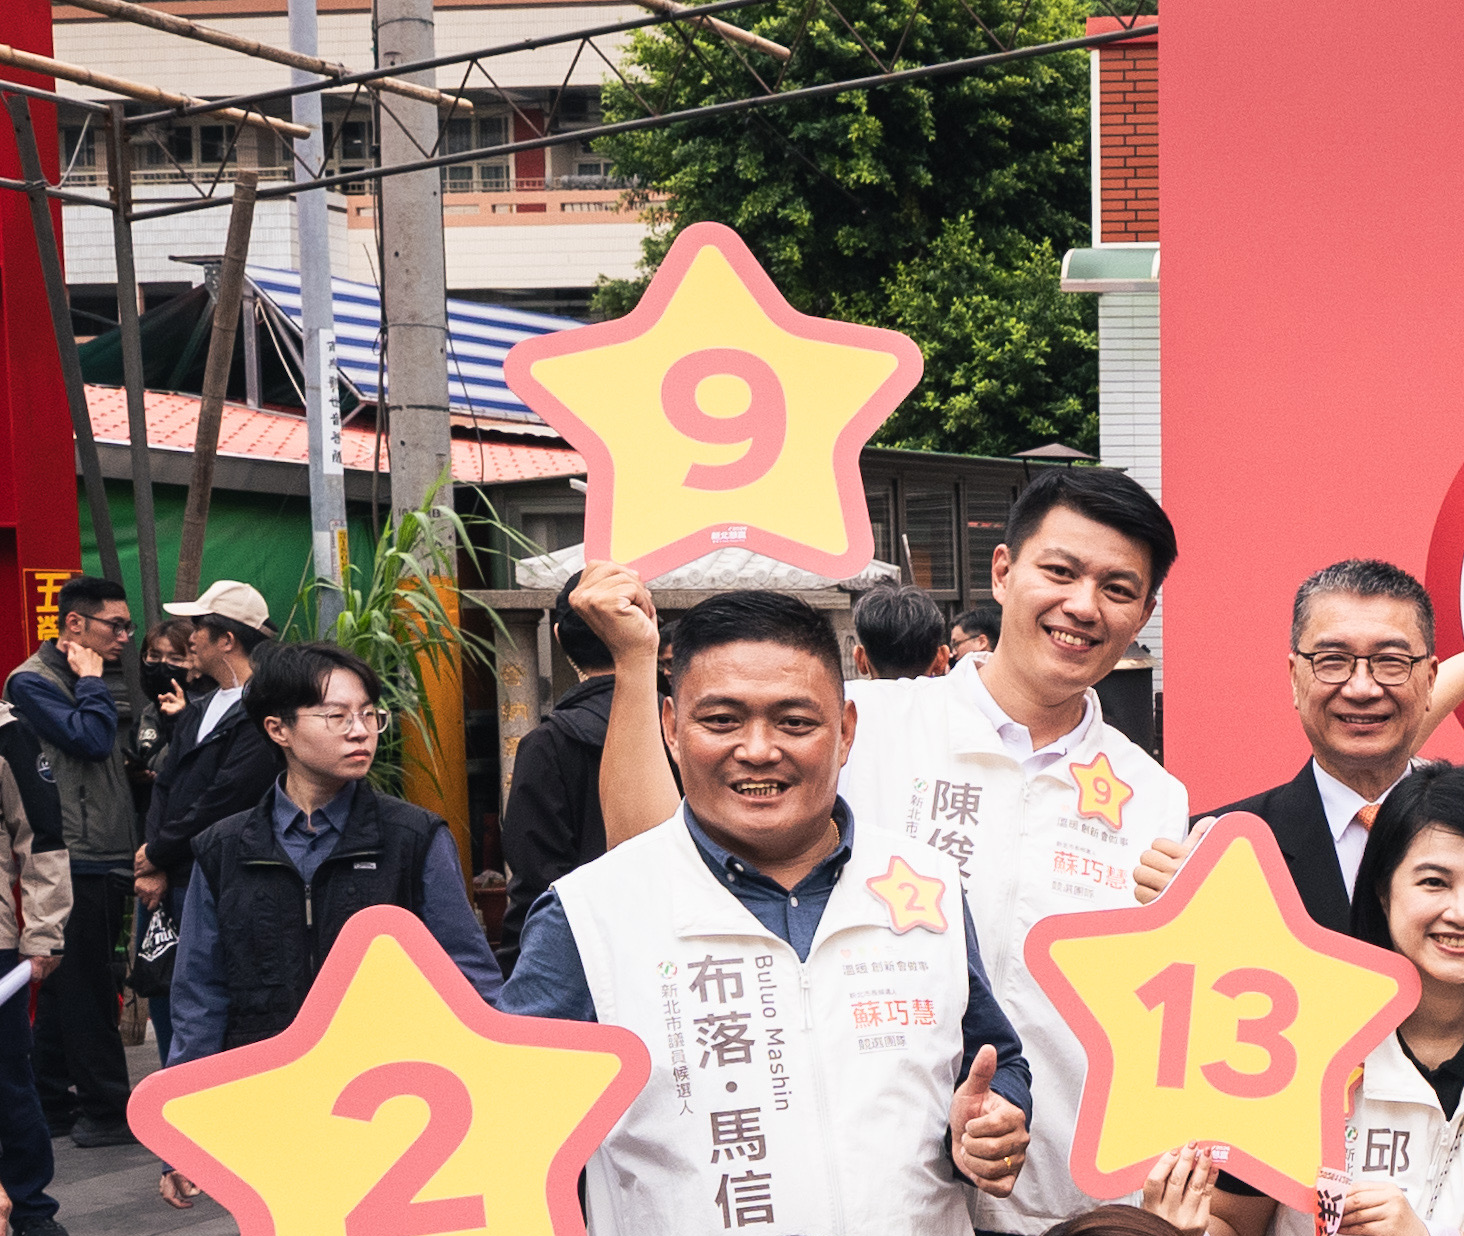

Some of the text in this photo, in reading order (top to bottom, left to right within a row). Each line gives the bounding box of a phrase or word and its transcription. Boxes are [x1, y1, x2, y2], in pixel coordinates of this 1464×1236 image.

[661, 348, 787, 491] 9
[905, 794, 923, 839] 新北市
[926, 779, 984, 894] 陳俊
[1093, 777, 1111, 804] 9
[897, 882, 927, 911] 2
[660, 983, 694, 1116] 新北市議員候選人
[755, 954, 793, 1111] Buluo Mashin
[850, 998, 938, 1029] 蘇巧慧
[1133, 961, 1300, 1099] 13
